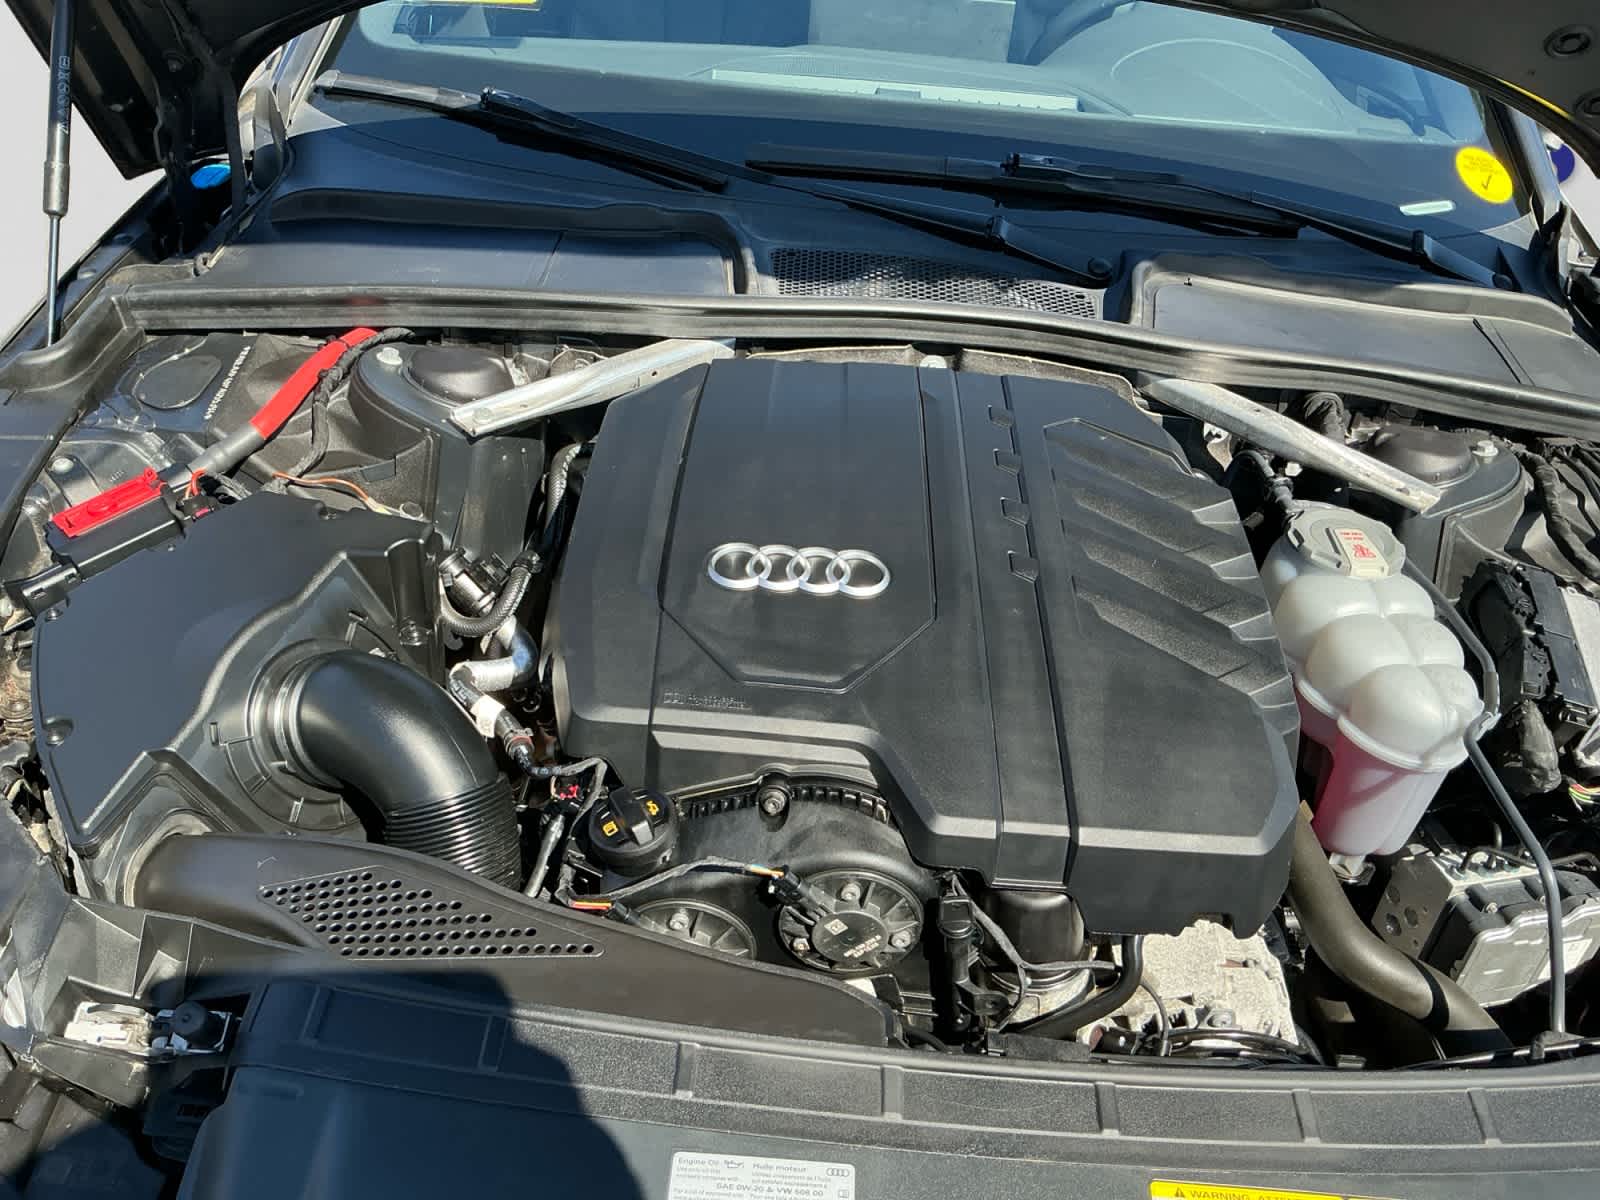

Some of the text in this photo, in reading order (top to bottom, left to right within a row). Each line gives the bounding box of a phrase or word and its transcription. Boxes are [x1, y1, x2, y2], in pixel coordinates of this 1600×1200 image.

[678, 1157, 706, 1167] Engine
[775, 1165, 807, 1173] moteur
[716, 1182, 734, 1190] SAE
[776, 1186, 792, 1195] VW
[1190, 1190, 1250, 1200] WARNING
